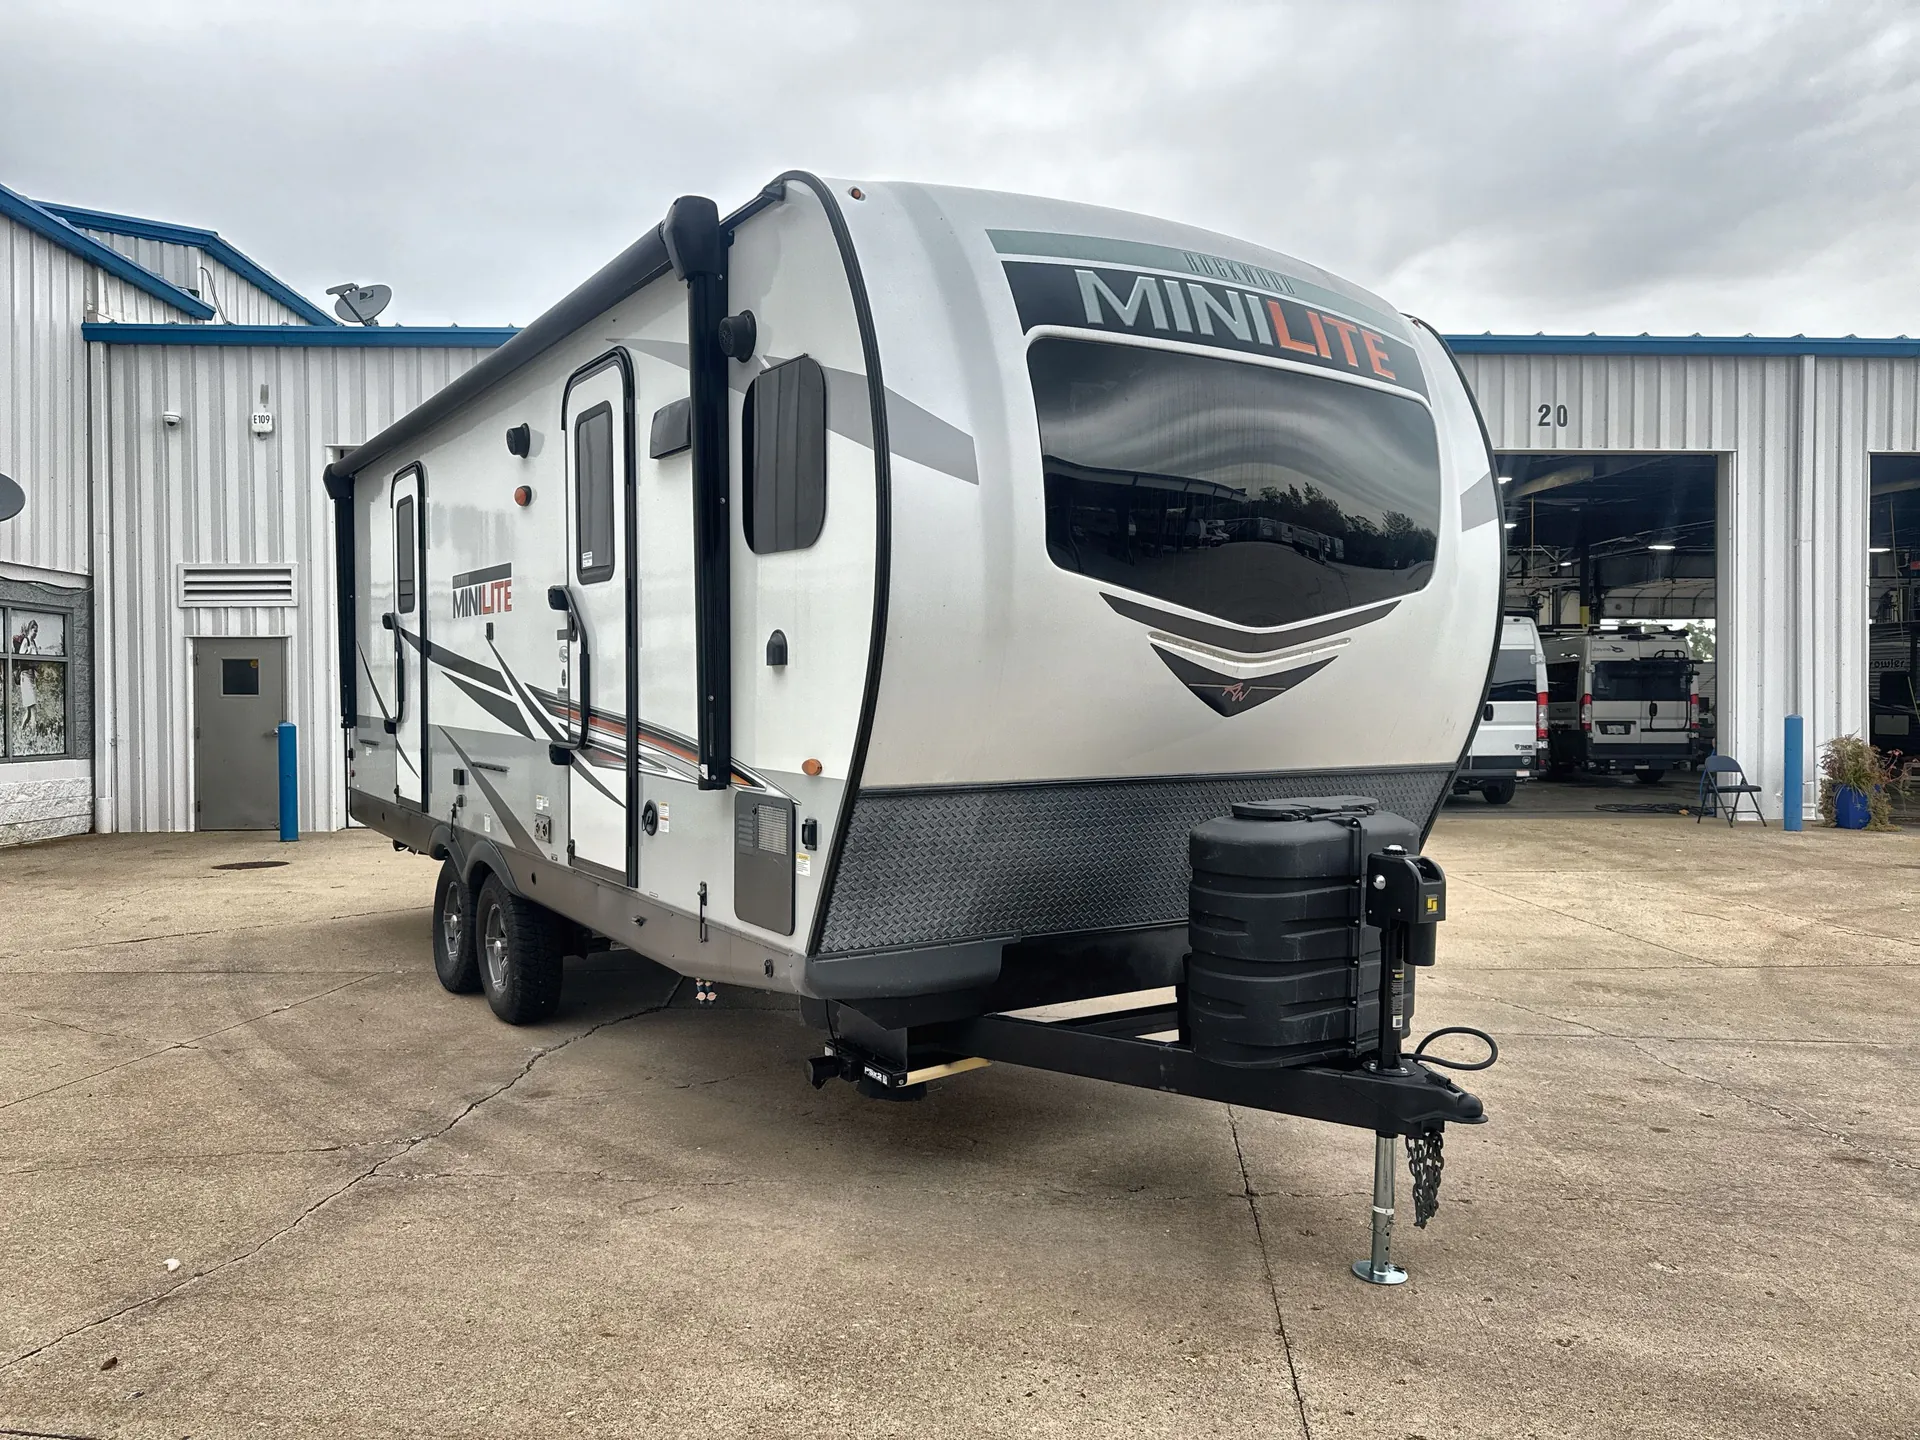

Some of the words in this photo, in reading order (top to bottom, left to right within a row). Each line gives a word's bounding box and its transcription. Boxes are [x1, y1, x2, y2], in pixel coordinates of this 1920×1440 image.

[1182, 251, 1296, 295] ROCKWOOD
[1074, 269, 1396, 381] MINILITE
[253, 414, 271, 424] E109
[1538, 404, 1568, 428] 20
[452, 579, 513, 619] MINILITE
